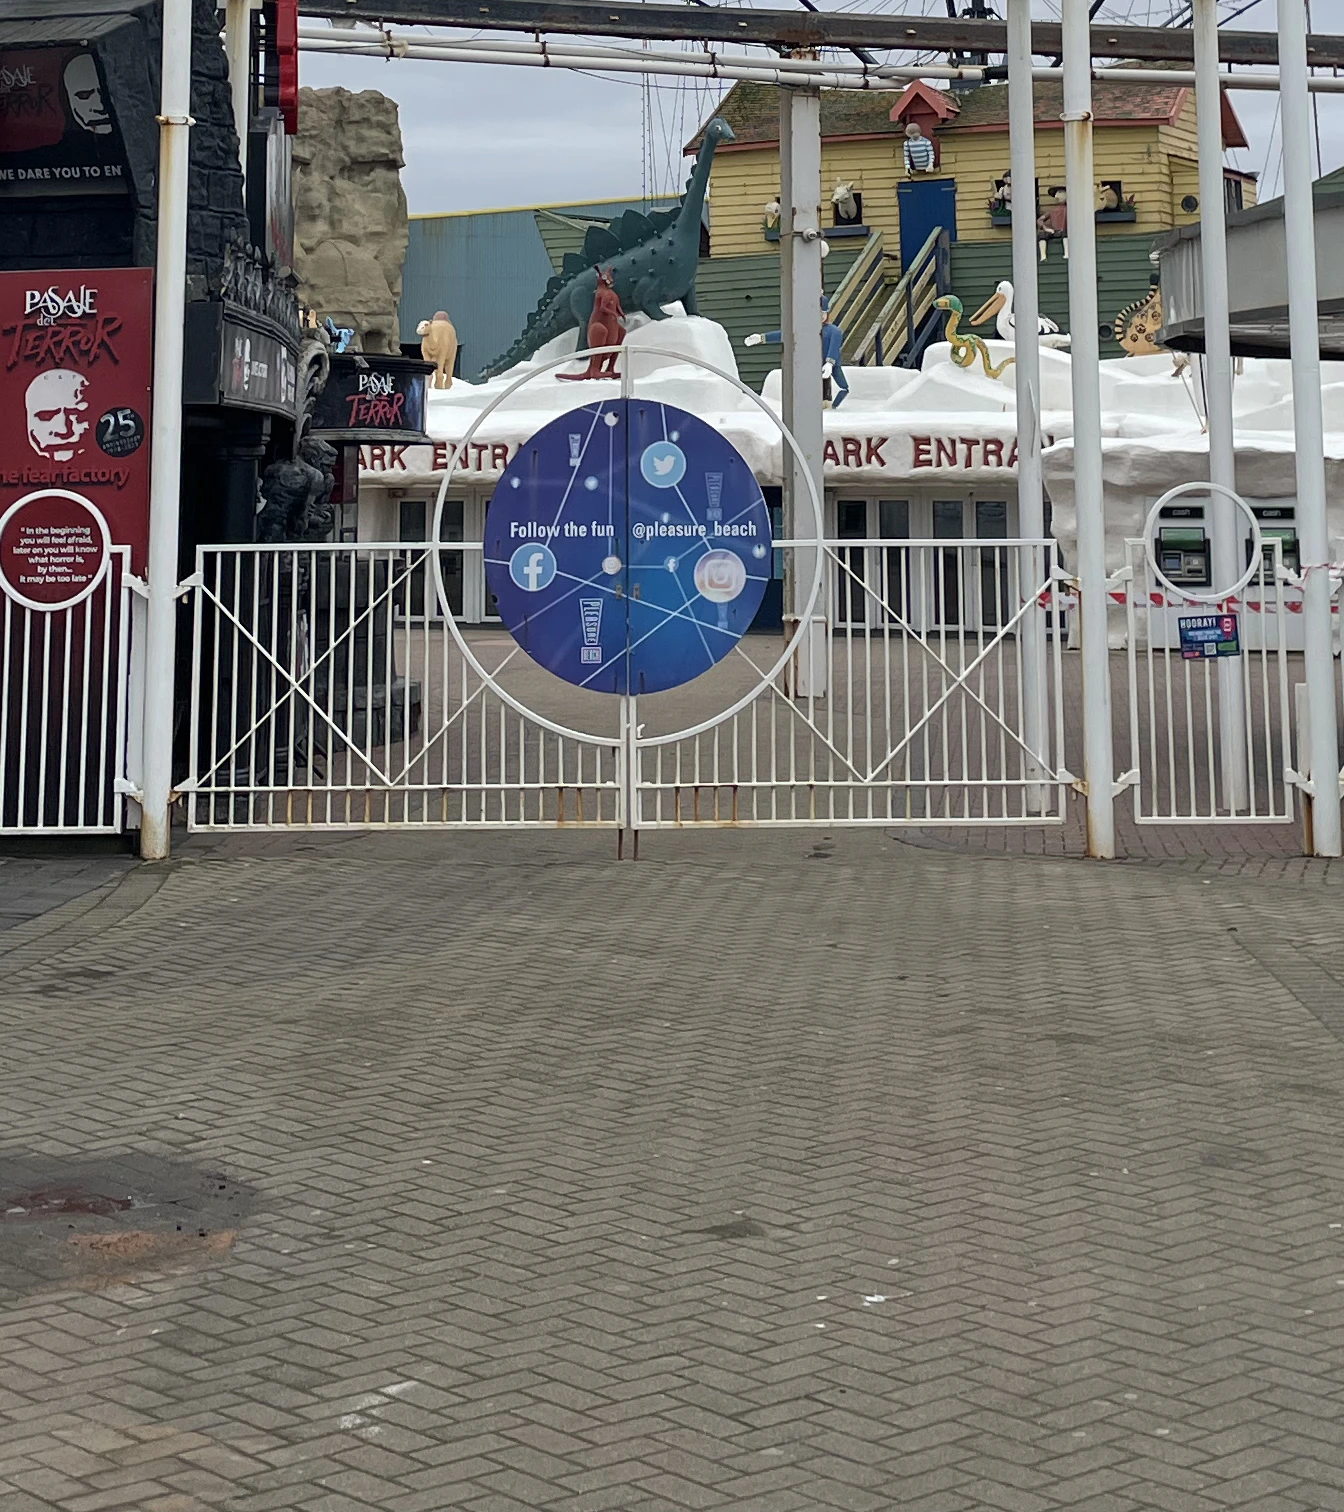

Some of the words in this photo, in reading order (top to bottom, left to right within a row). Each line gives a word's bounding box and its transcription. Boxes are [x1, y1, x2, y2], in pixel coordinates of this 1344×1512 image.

[18, 168, 51, 179] DARE
[52, 167, 79, 178] YOU
[83, 166, 100, 177] TO
[104, 165, 122, 176] EN
[24, 285, 98, 317] PASAJE
[2, 316, 122, 371] TERROR
[345, 393, 404, 427] TERROR
[358, 444, 410, 471] ARK
[432, 440, 524, 471] ENTR
[823, 437, 889, 467] ARK
[22, 465, 60, 483] fear
[62, 465, 129, 487] factory
[50, 525, 90, 536] beginning
[510, 521, 560, 538] Follow
[564, 521, 587, 537] the
[591, 521, 615, 537] fun
[632, 521, 757, 540] @pleasure_beach
[20, 538, 35, 546] you
[36, 536, 50, 544] will
[51, 535, 66, 544] feel
[44, 547, 59, 555] you
[50, 555, 74, 563] horror
[37, 565, 47, 574] by
[27, 576, 44, 584] may
[583, 601, 600, 644] PLEASURE
